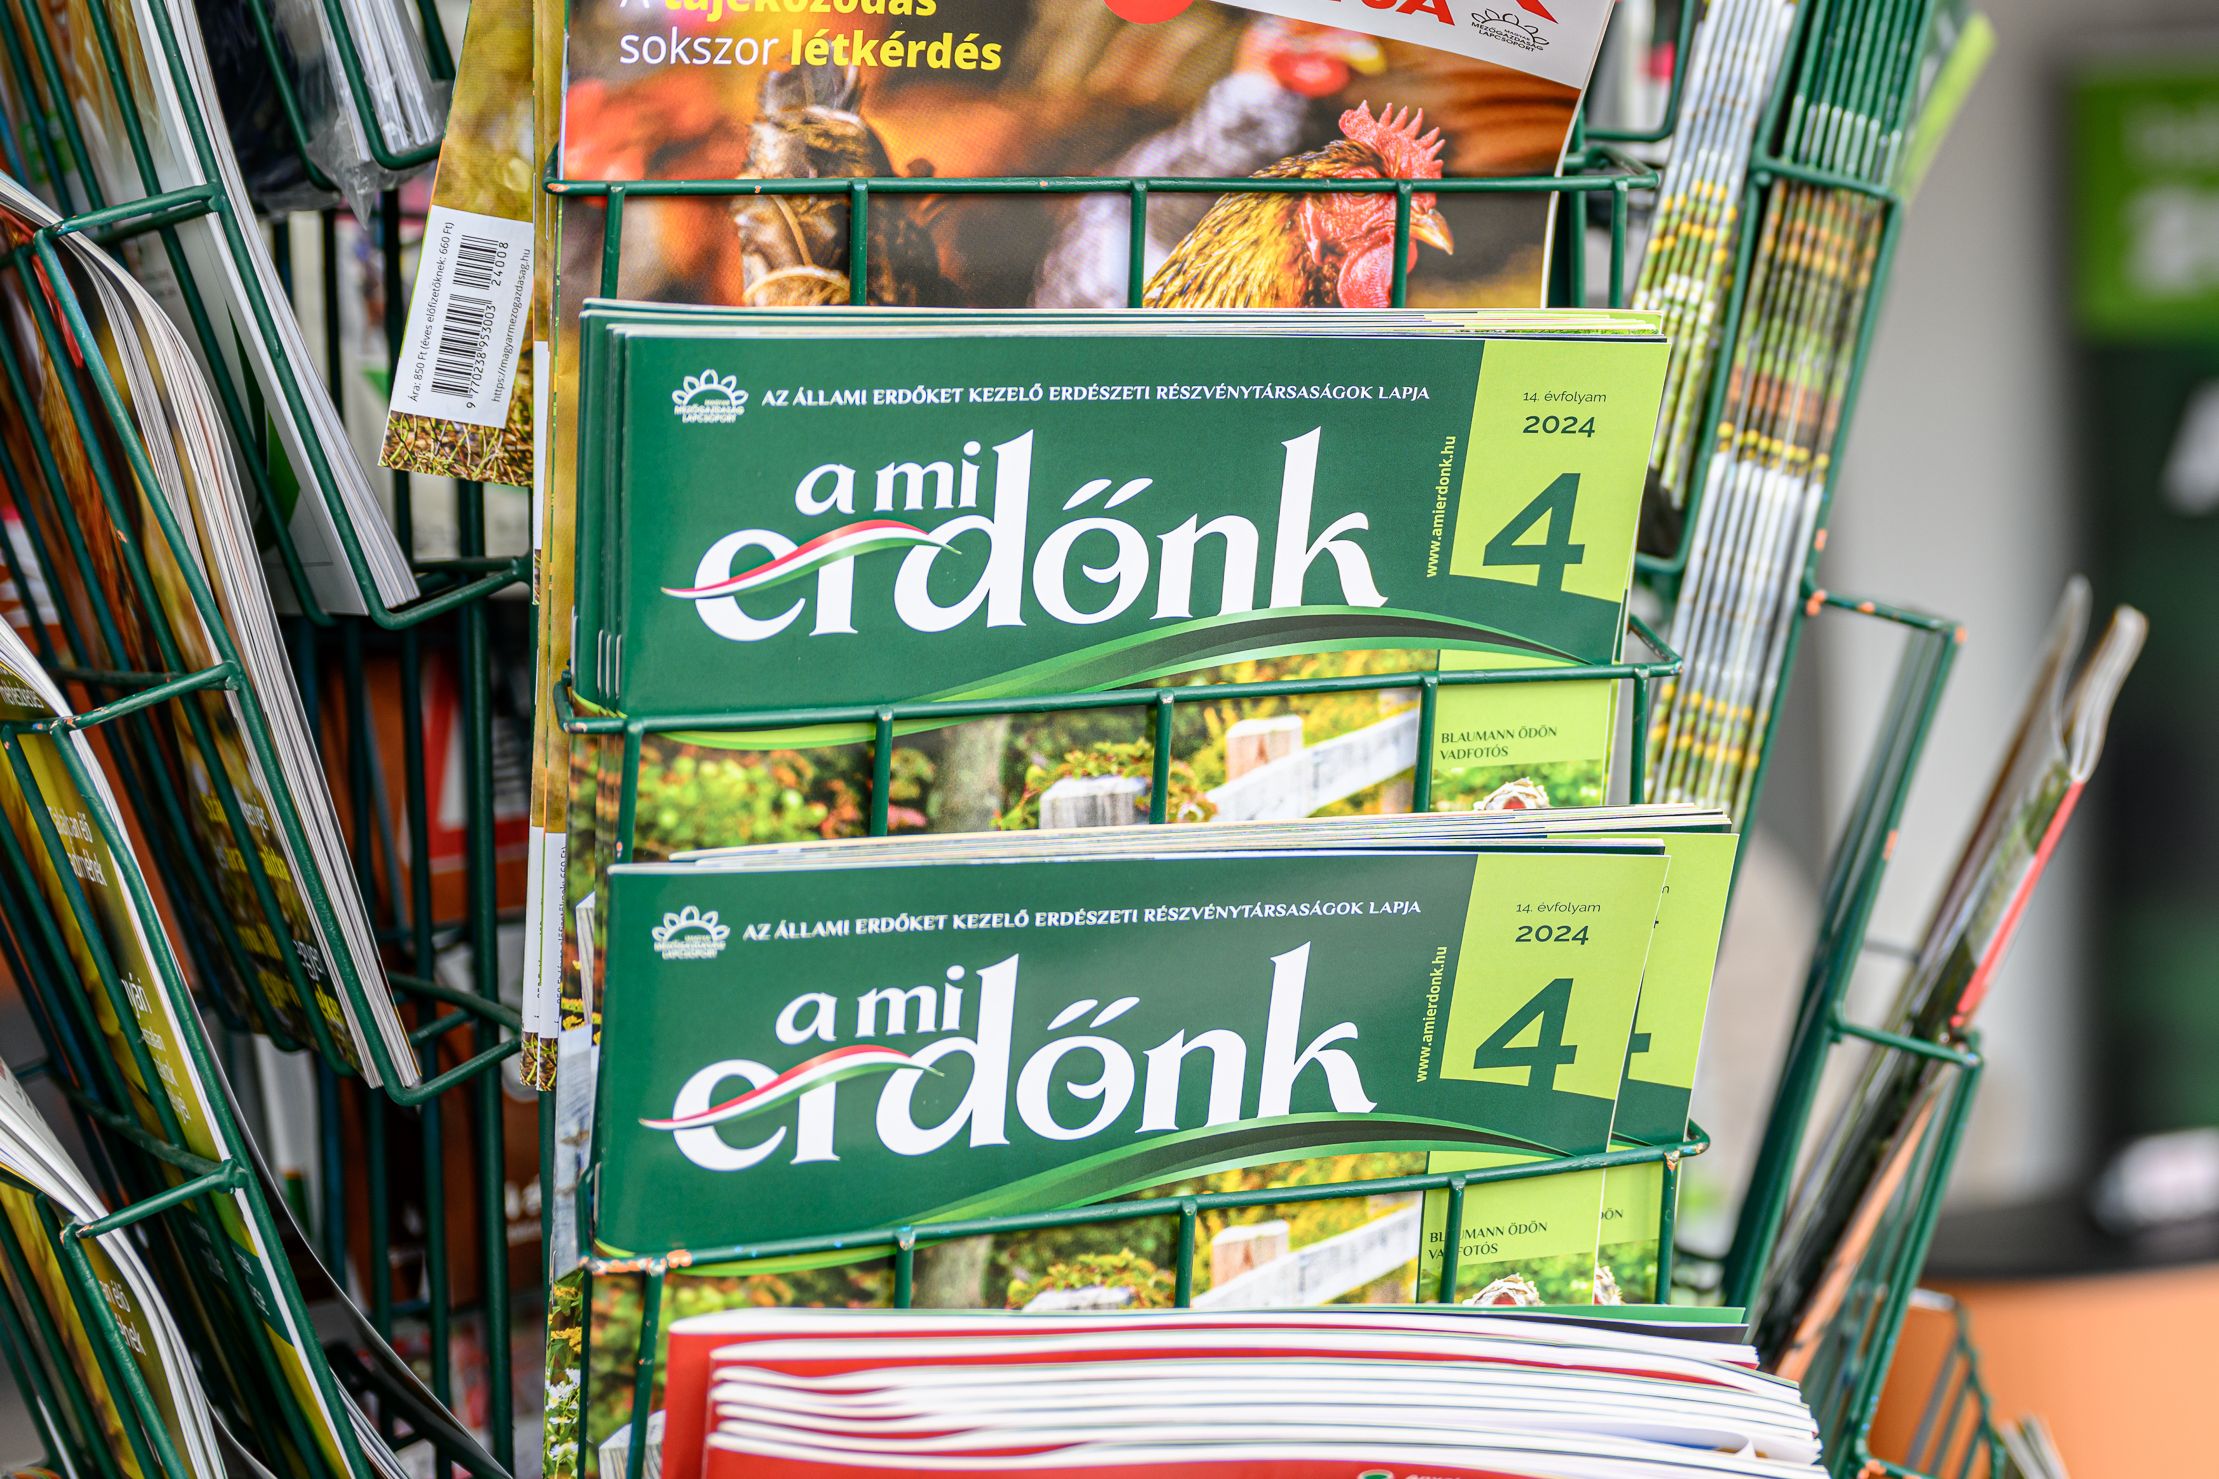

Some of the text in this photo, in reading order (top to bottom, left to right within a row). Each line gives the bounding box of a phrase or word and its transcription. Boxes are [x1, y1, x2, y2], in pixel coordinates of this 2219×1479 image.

[620, 26, 1002, 71] sokszor létkérdés
[1479, 30, 1535, 52] LAPCSOPORT
[491, 242, 509, 287] 24008
[408, 222, 455, 402] Ára: 850 Ft (éves előfizetőknek: 660 Ft)
[491, 248, 531, 403] https://magyarmezogazdasag.hu
[762, 382, 1430, 407] AZ ÁLLAMI ERDŐKET KEZELŐ ERDÉSZETI RÉSZVÉNYTÁRSASÁGOK LAPJA
[1523, 390, 1608, 404] 14. évfolyam
[1522, 415, 1596, 437] 2024
[795, 441, 982, 516] a mi
[1426, 435, 1457, 578] www.amierdonk.hu
[694, 425, 1389, 642] erdőnk
[1482, 472, 1586, 591] 4
[1440, 745, 1509, 761] VADFOTÓS
[1441, 724, 1558, 744] BLAUMANN ÖDÖN
[742, 899, 1422, 941] AZ ÁLLAMI ERDŐKET KEZELŐ ERDÉSZETI RÉSZVÉNYTÁRSASÁGOK LAPJA
[1515, 901, 1602, 914] 14. évfolyam
[1515, 924, 1590, 946] 2024
[775, 963, 966, 1045] a mi
[1416, 945, 1448, 1084] www.amierdonk.hu
[671, 940, 1378, 1173] erdőnk
[1473, 977, 1579, 1091] 4
[1508, 1221, 1549, 1236] ÖDÖN
